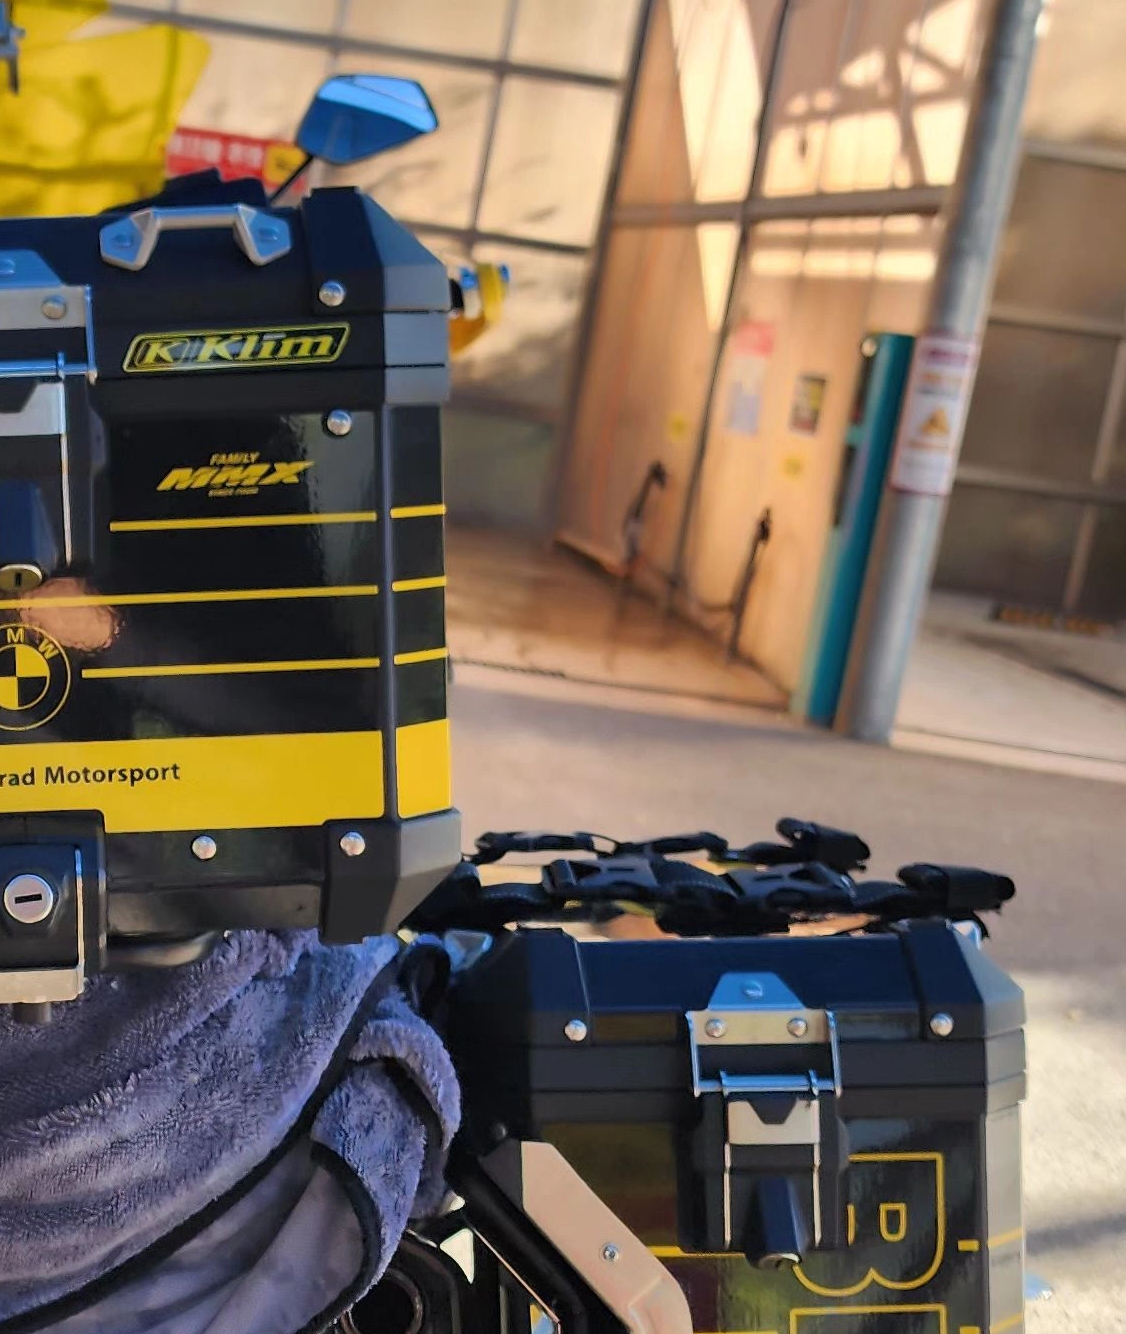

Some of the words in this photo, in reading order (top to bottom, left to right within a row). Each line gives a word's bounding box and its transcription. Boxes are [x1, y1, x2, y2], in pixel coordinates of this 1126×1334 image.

[195, 333, 335, 364] Klim
[155, 460, 315, 492] MMX
[43, 762, 181, 789] Motorsport
